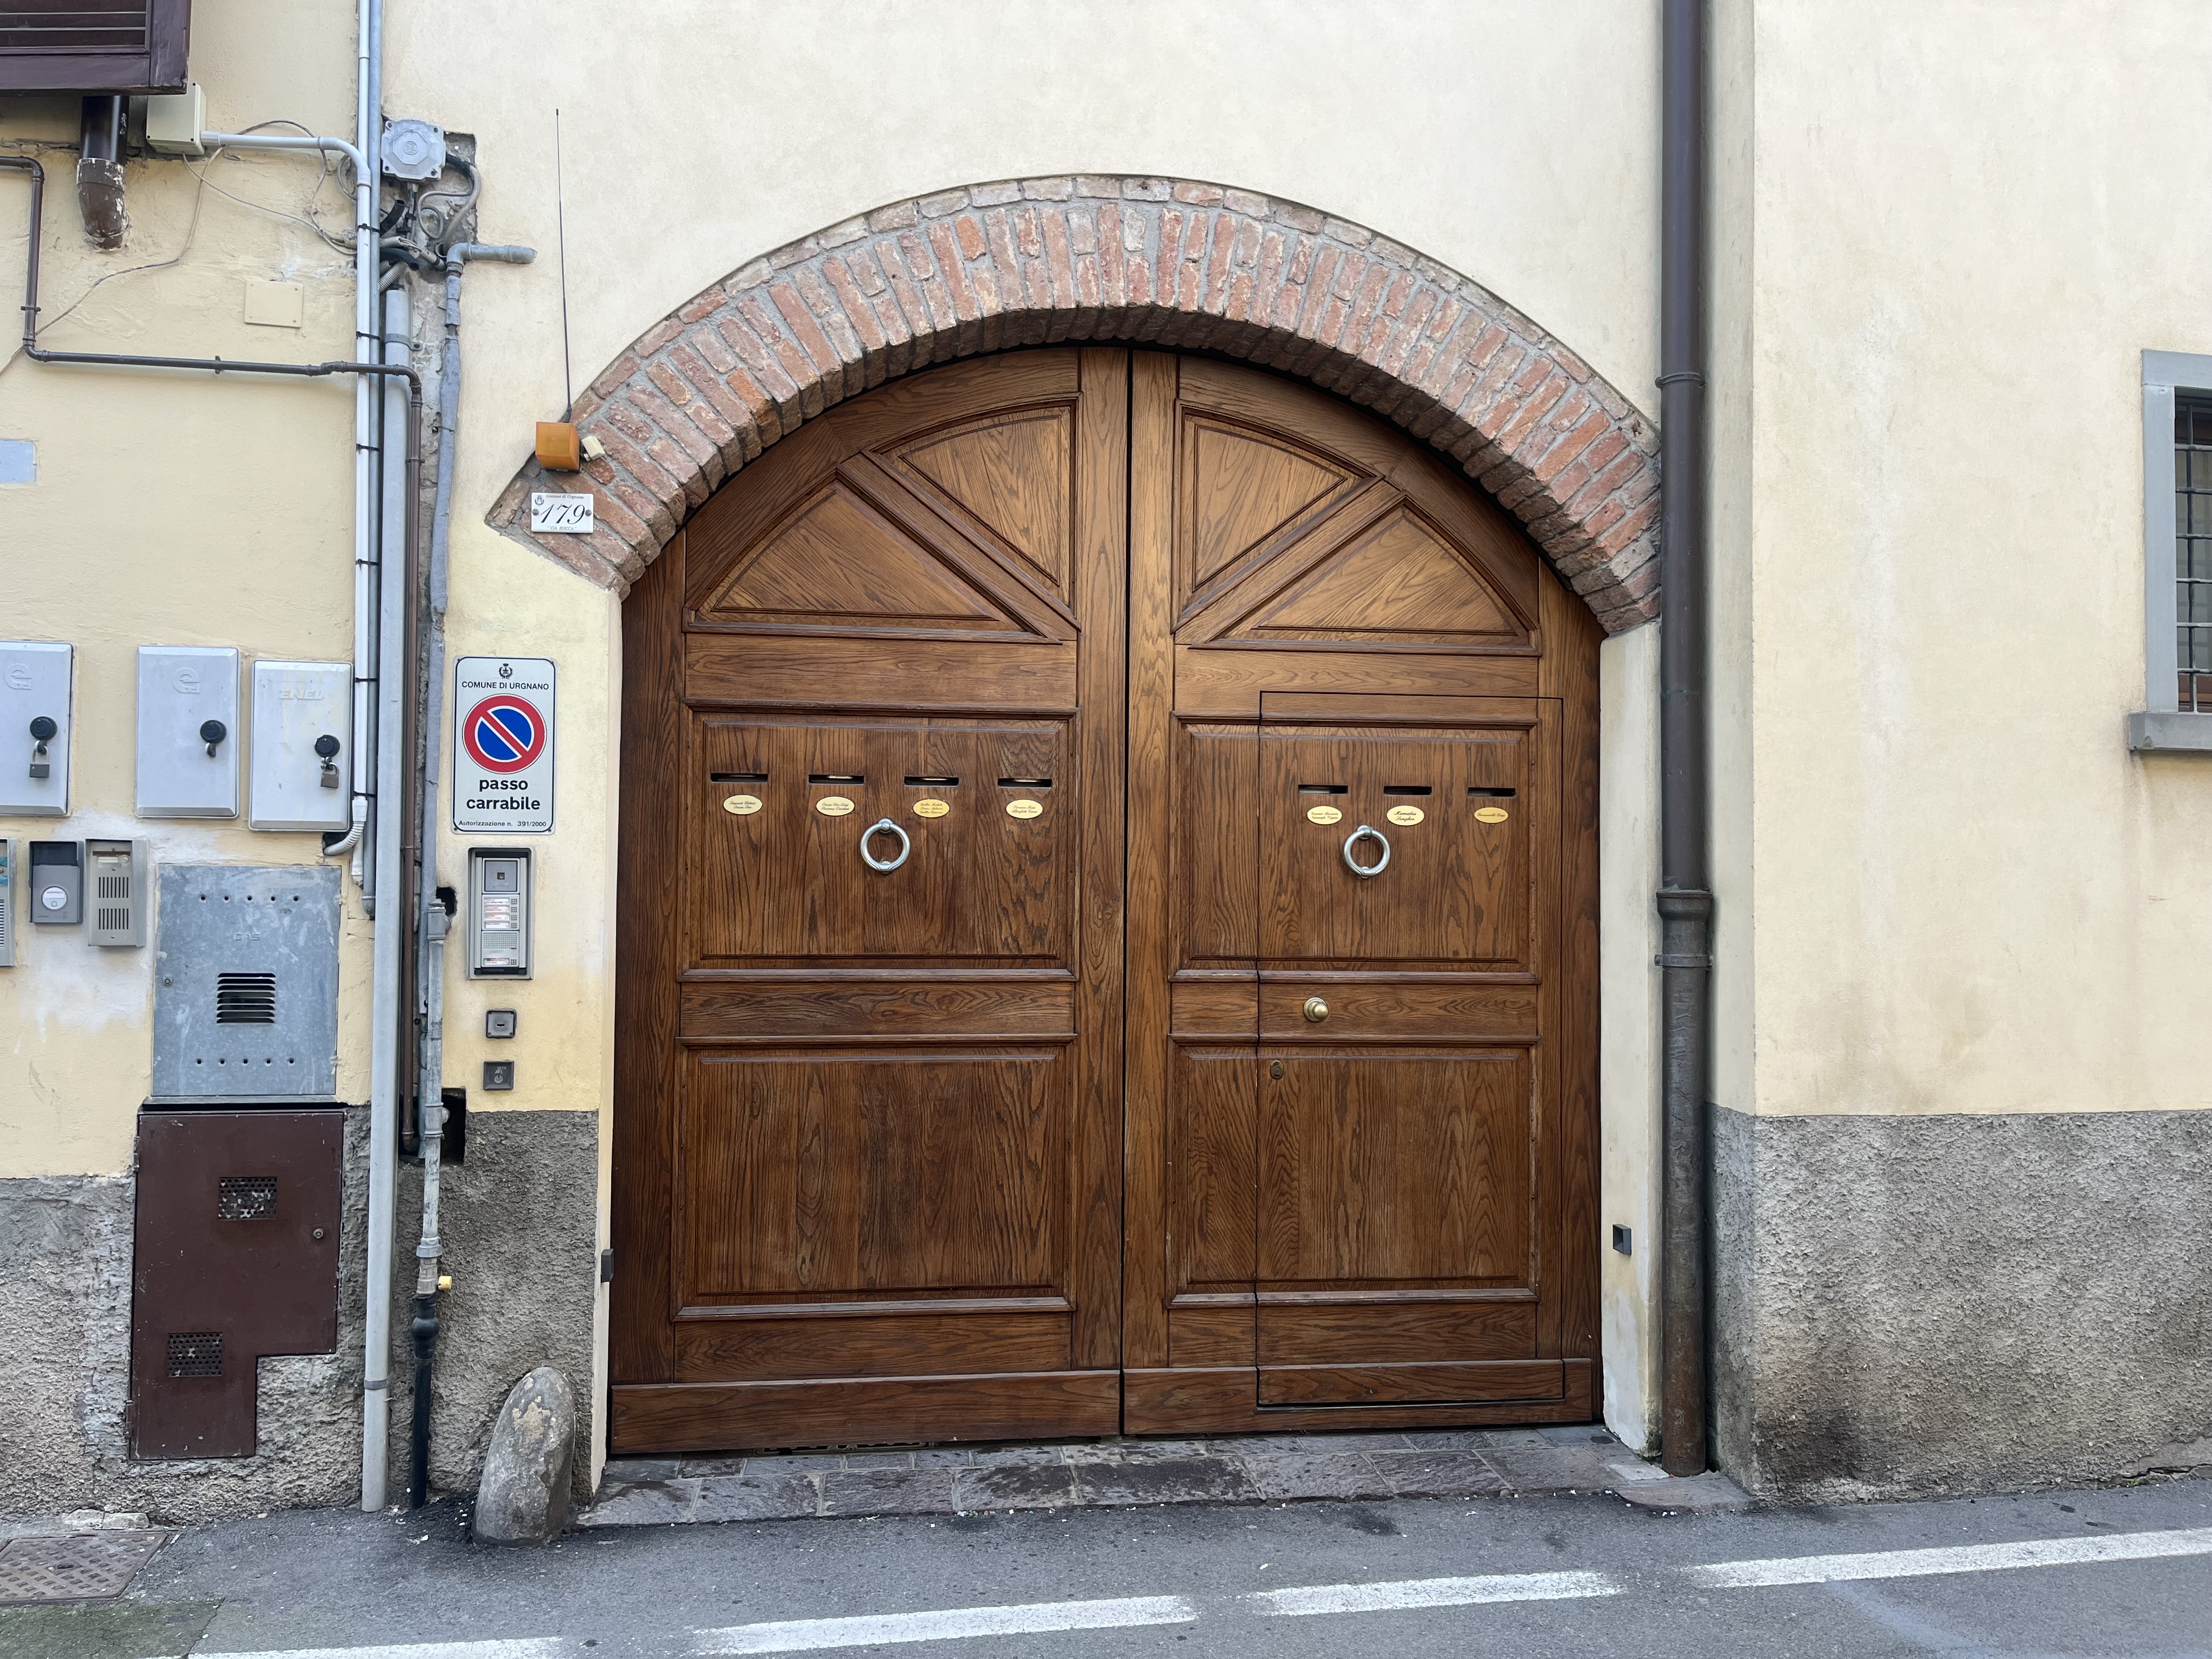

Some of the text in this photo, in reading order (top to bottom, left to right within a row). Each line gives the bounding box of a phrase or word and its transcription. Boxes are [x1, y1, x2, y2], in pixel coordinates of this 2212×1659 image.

[540, 503, 585, 524] 179
[461, 681, 497, 689] COMUNE
[279, 689, 324, 701] ENEL
[479, 778, 528, 792] passo
[466, 796, 540, 810] carrabile
[234, 932, 261, 941] GAS
